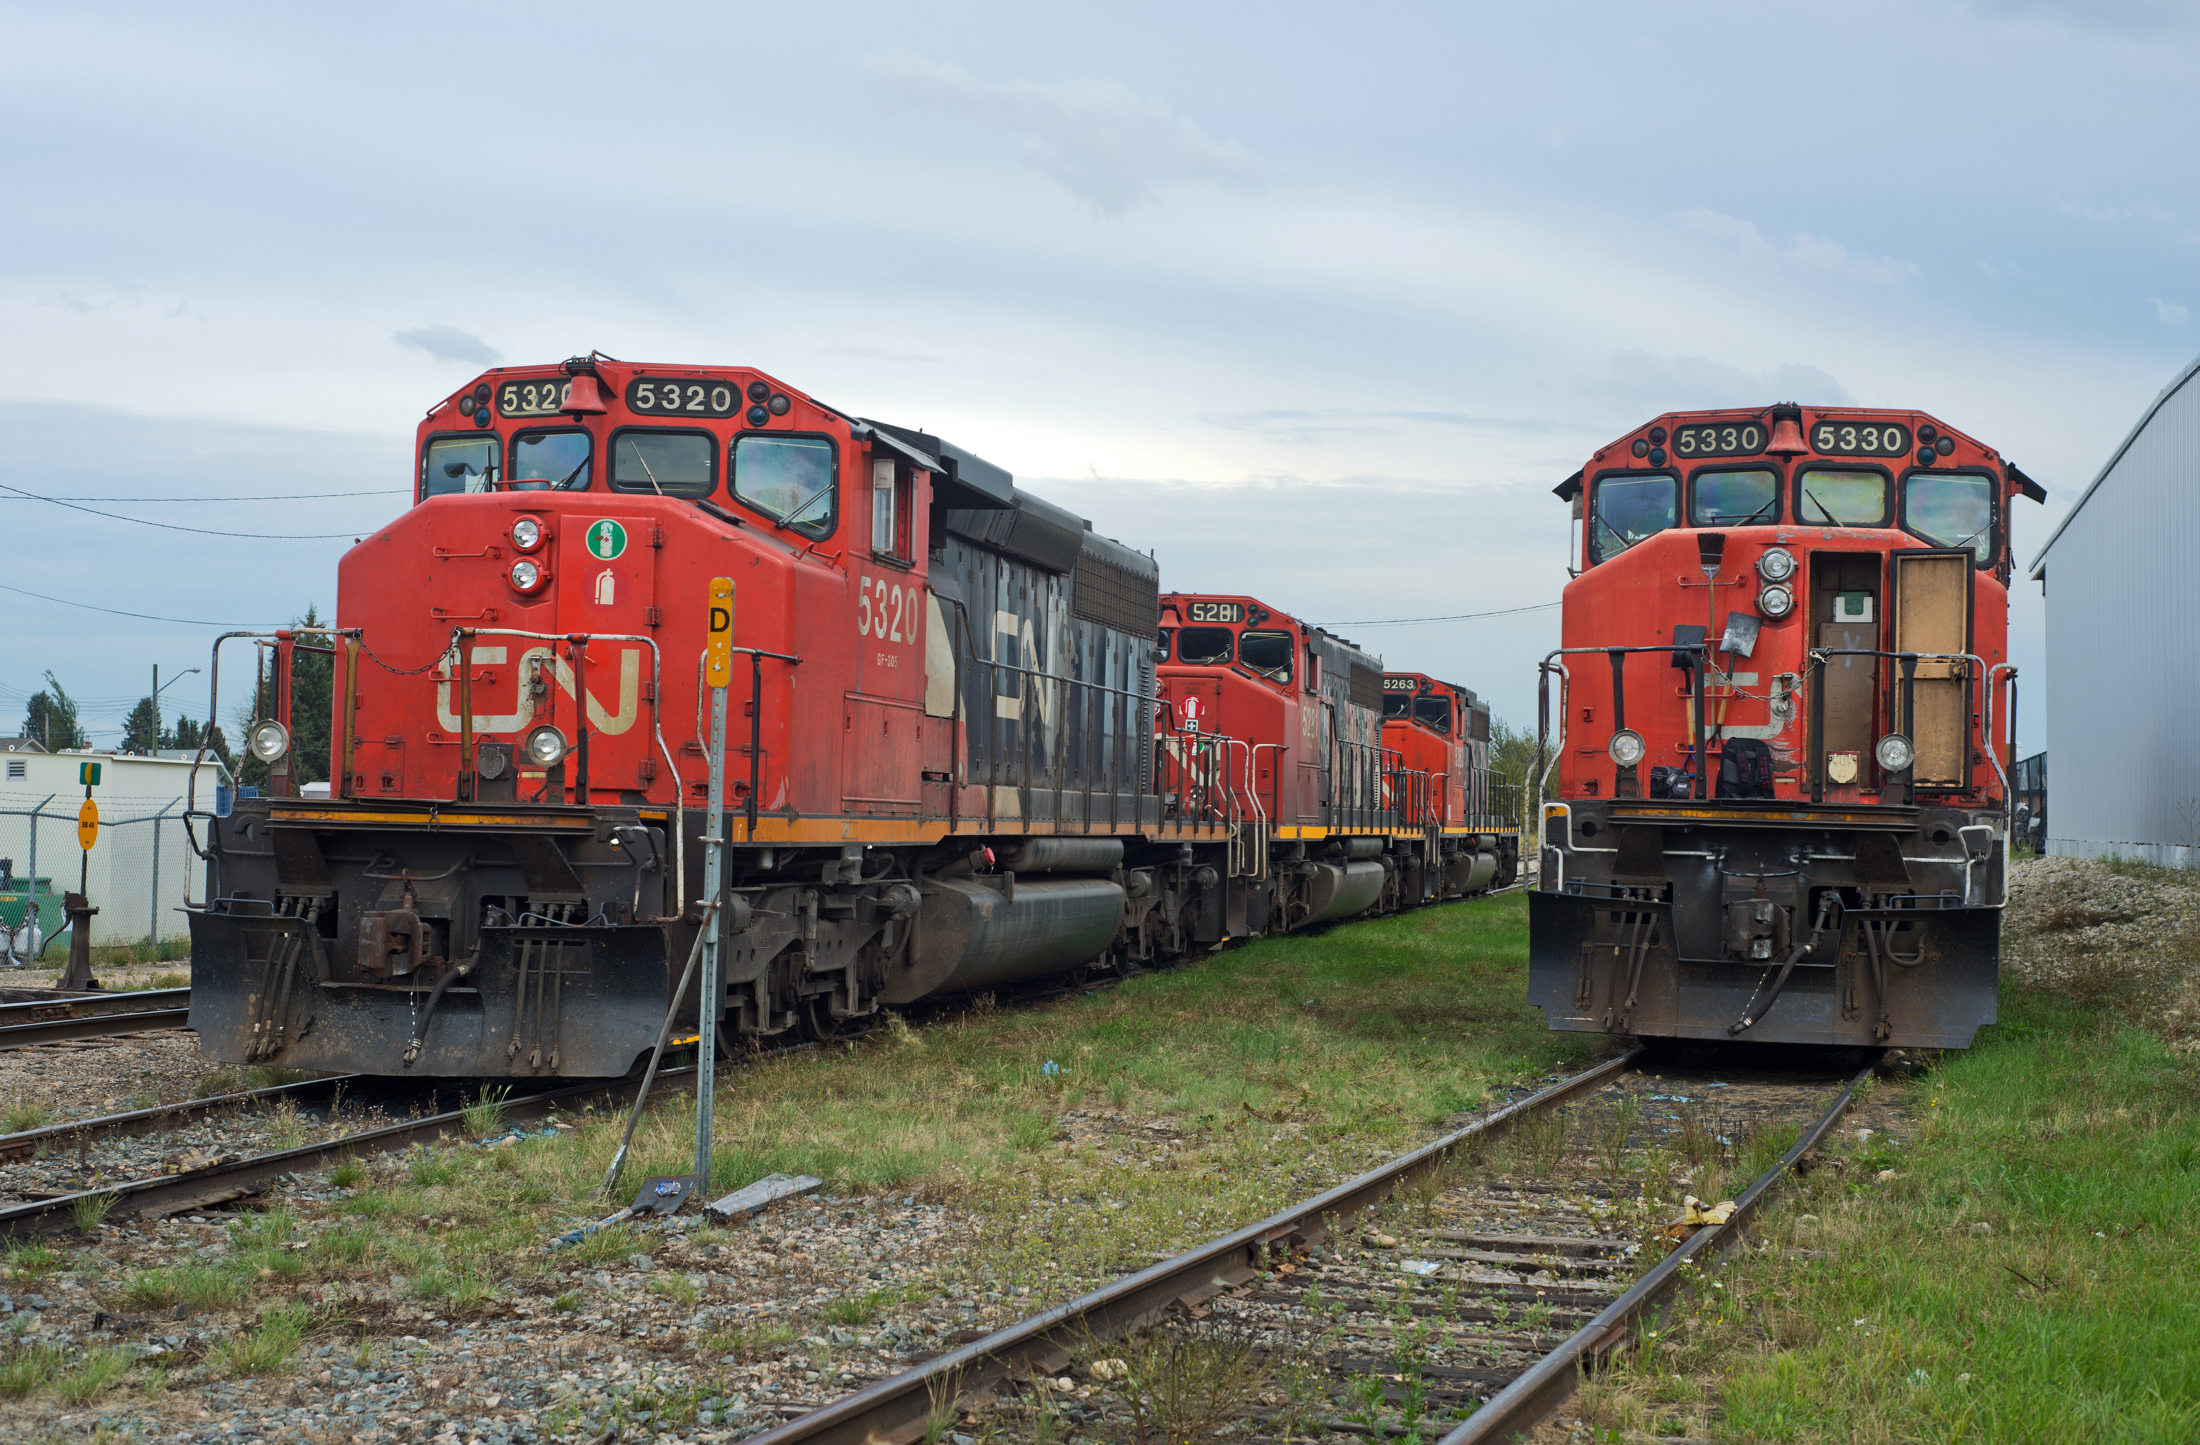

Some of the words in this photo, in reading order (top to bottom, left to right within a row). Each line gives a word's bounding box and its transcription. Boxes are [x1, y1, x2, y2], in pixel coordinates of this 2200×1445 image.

[636, 384, 731, 411] 5320
[1679, 427, 1759, 452] 5330
[1817, 427, 1901, 451] 5330
[710, 607, 730, 632] D
[858, 576, 918, 645] 5320
[1193, 603, 1238, 622] 5281
[437, 646, 640, 735] CN
[1383, 679, 1414, 689] 5263
